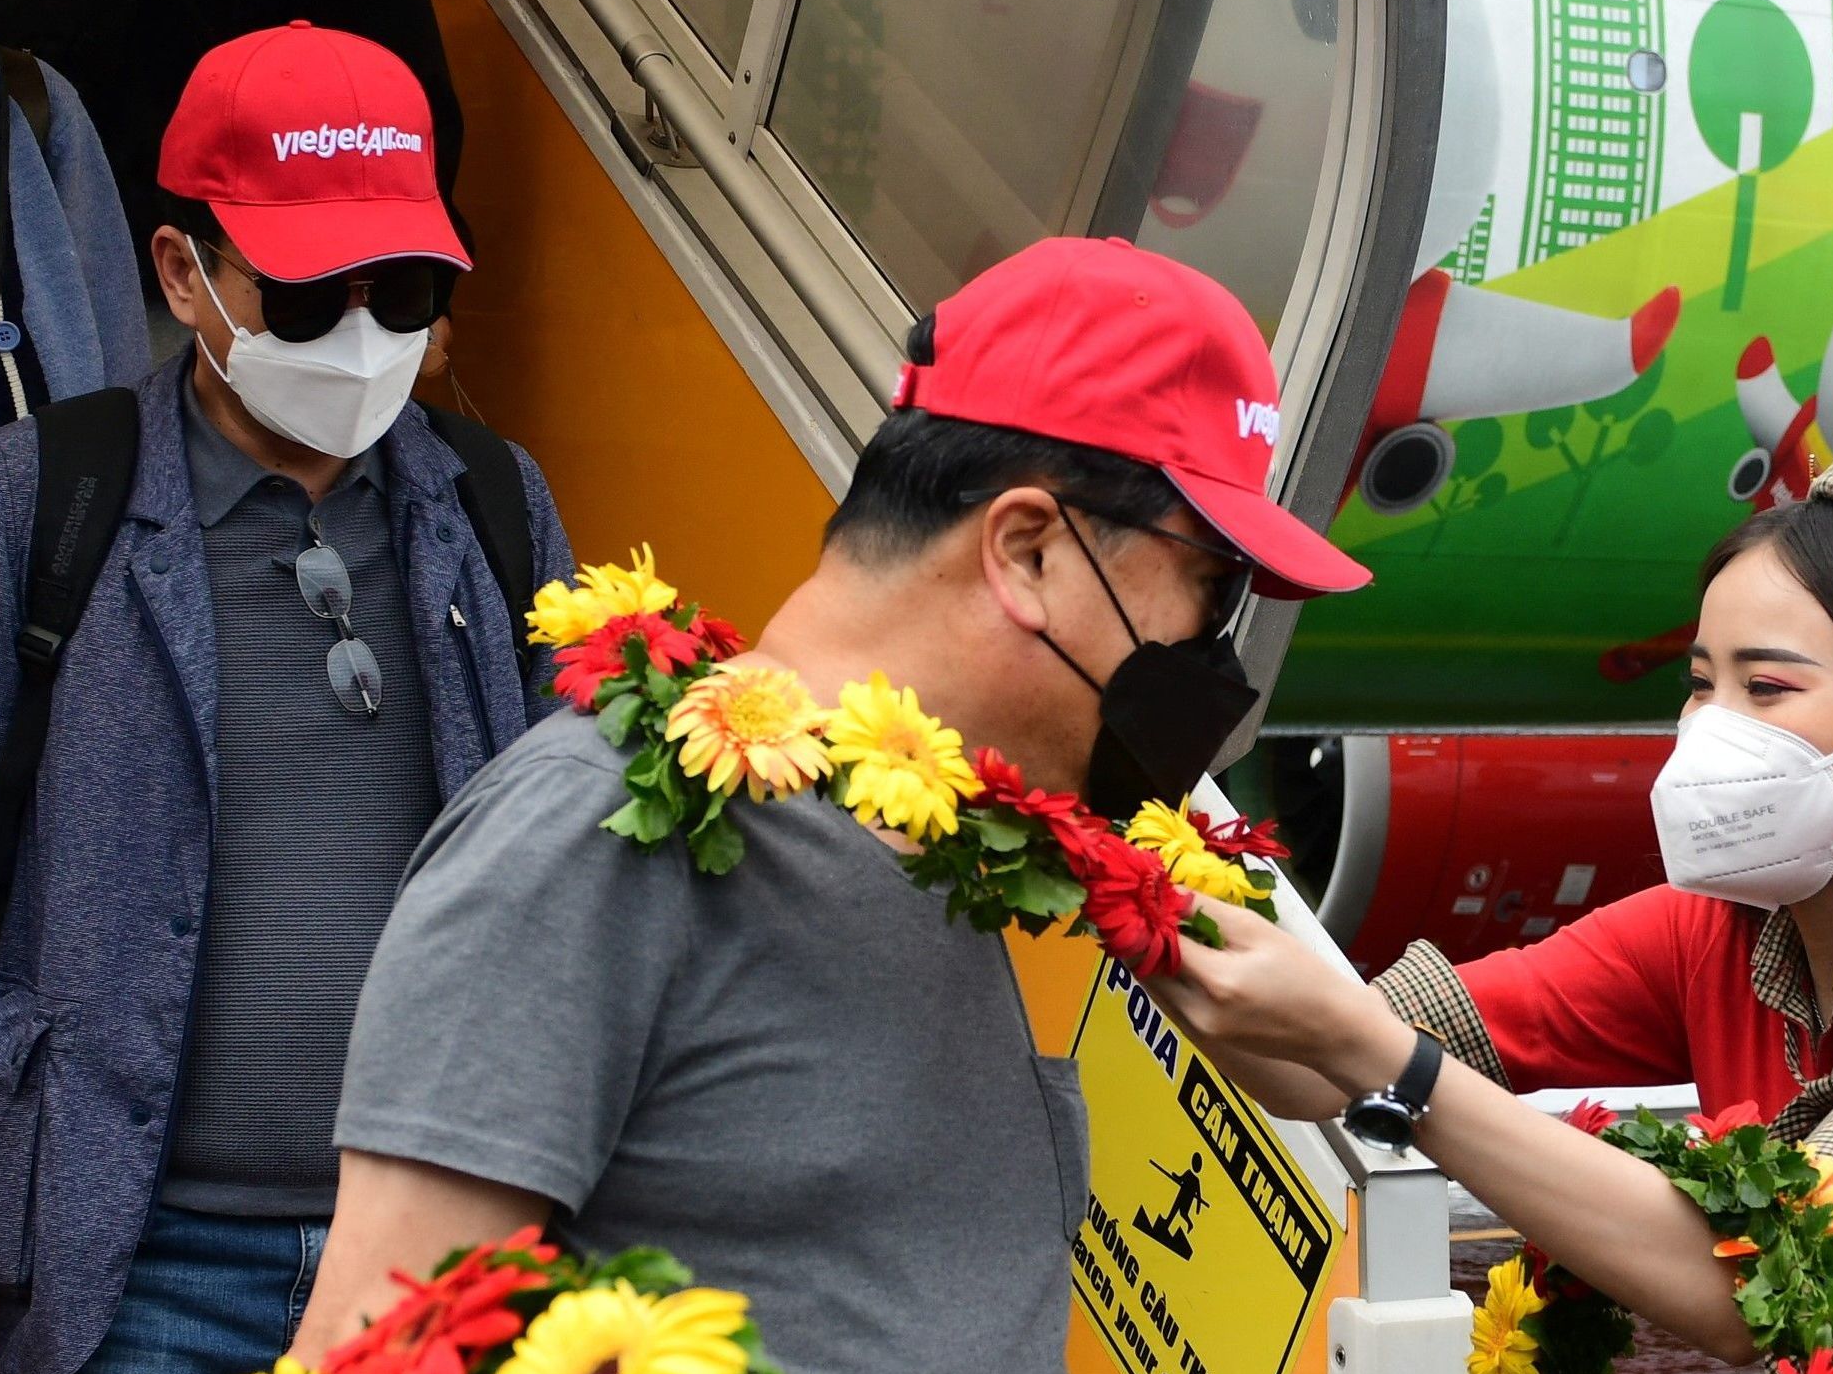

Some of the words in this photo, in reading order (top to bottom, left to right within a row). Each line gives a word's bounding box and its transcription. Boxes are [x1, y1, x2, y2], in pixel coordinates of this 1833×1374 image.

[1688, 812, 1740, 832] DOUBLE
[1742, 803, 1776, 820] SAFE
[1107, 957, 1179, 1079] PQIA
[1190, 1082, 1239, 1163] CẨN
[1241, 1151, 1312, 1270] THẬN!
[1071, 1229, 1115, 1311] atch
